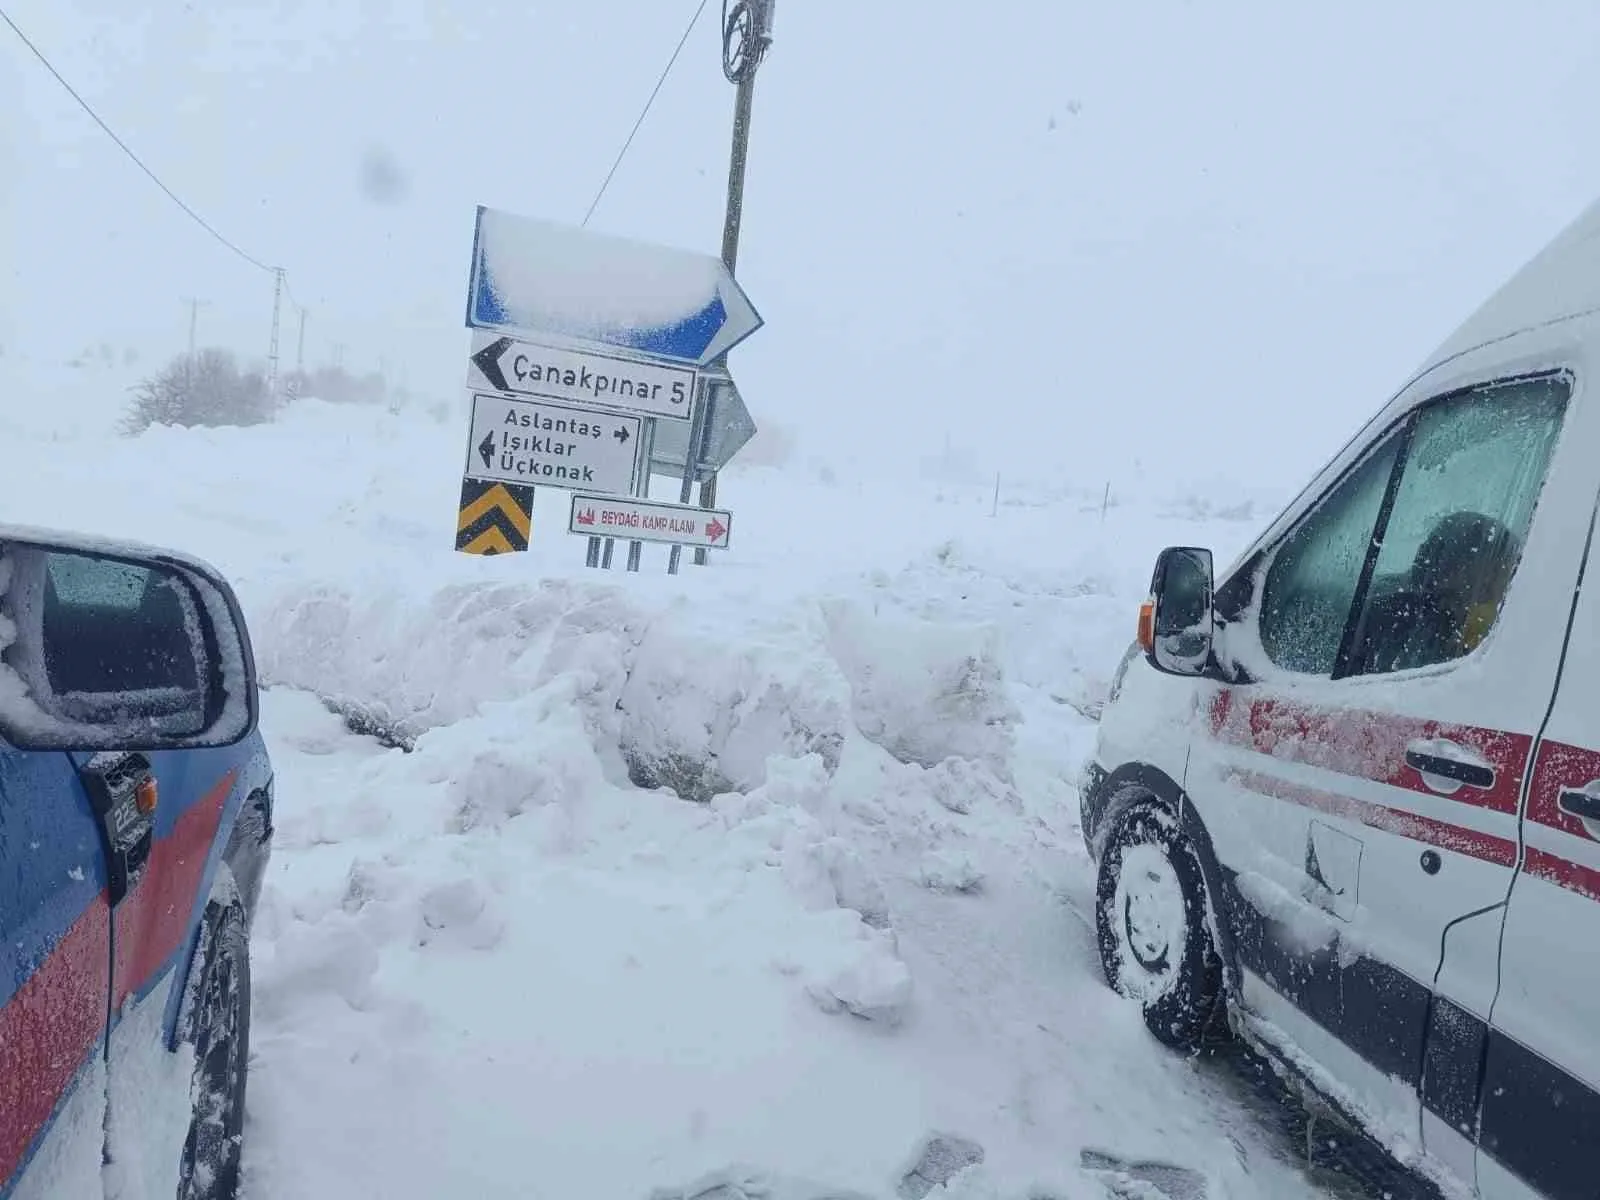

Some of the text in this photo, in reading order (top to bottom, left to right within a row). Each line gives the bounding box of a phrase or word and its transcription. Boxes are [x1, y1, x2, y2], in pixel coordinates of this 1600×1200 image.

[513, 354, 685, 404] Çanakpınar 5
[504, 409, 602, 439] Aslantaş
[503, 431, 577, 456] Işıklar
[501, 451, 595, 481] Üçkonak
[601, 510, 696, 536] BEYDAĞI KAMP ALANI
